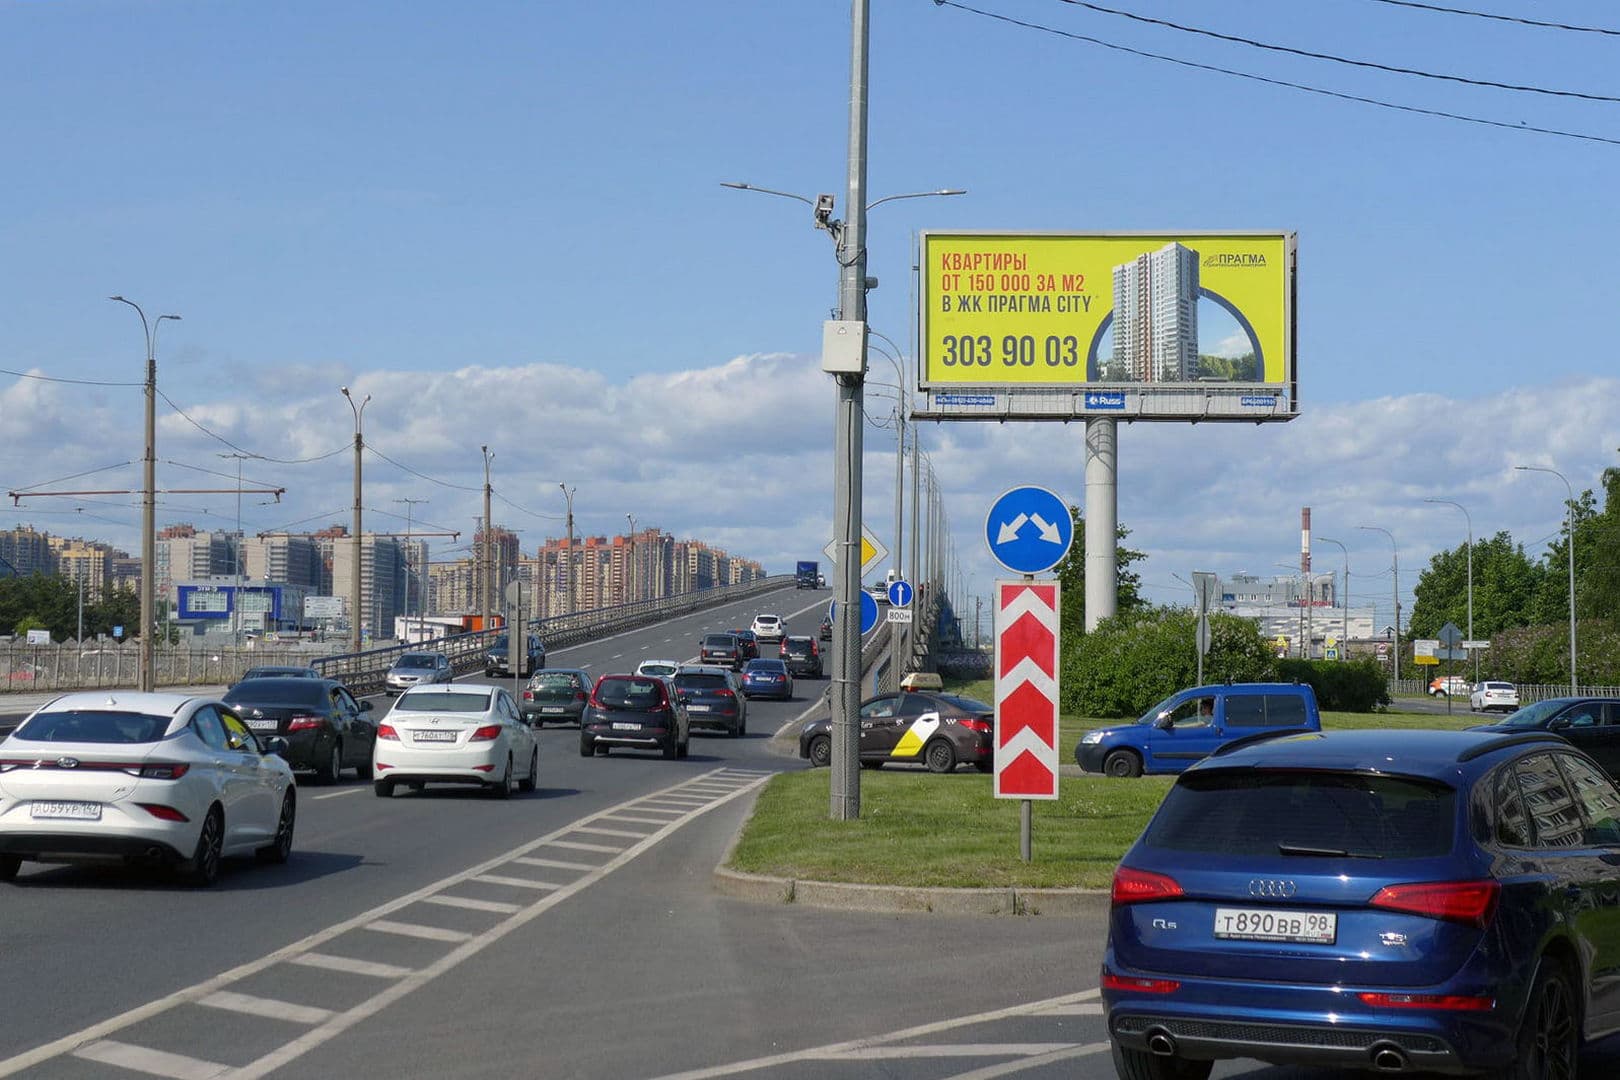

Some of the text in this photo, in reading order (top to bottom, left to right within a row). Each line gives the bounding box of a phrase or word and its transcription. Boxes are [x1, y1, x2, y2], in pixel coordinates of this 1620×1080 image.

[942, 253, 1027, 271] КВАРТИРЫ
[1219, 253, 1266, 264] ПРАГМА
[942, 274, 1084, 292] ОТ 150 000 ЗА М2
[942, 295, 1092, 313] В ЖК ПРАГМА CITY
[942, 335, 1078, 367] 303 90 03
[1224, 913, 1328, 935] Т890ВВ 98
